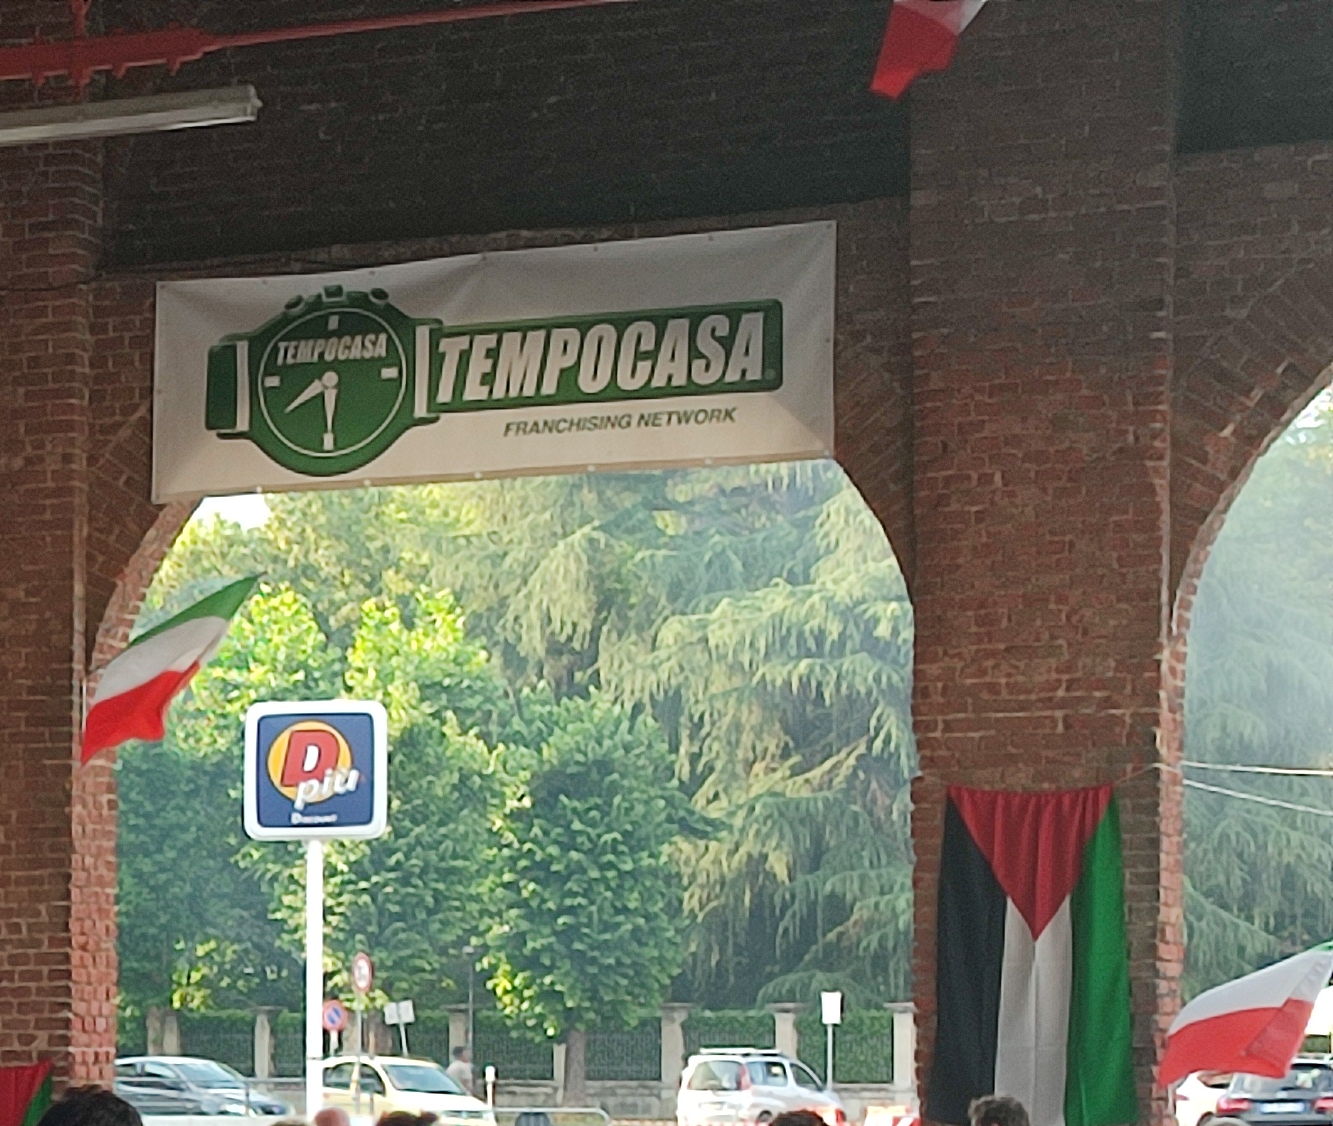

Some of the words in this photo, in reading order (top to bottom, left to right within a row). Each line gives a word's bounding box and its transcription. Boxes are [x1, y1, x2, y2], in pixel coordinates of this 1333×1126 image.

[277, 333, 387, 366] TEMPOCASA
[436, 311, 764, 403] TEMPOCASA
[503, 414, 632, 438] FRANCHISING
[637, 407, 737, 428] NETWORK
